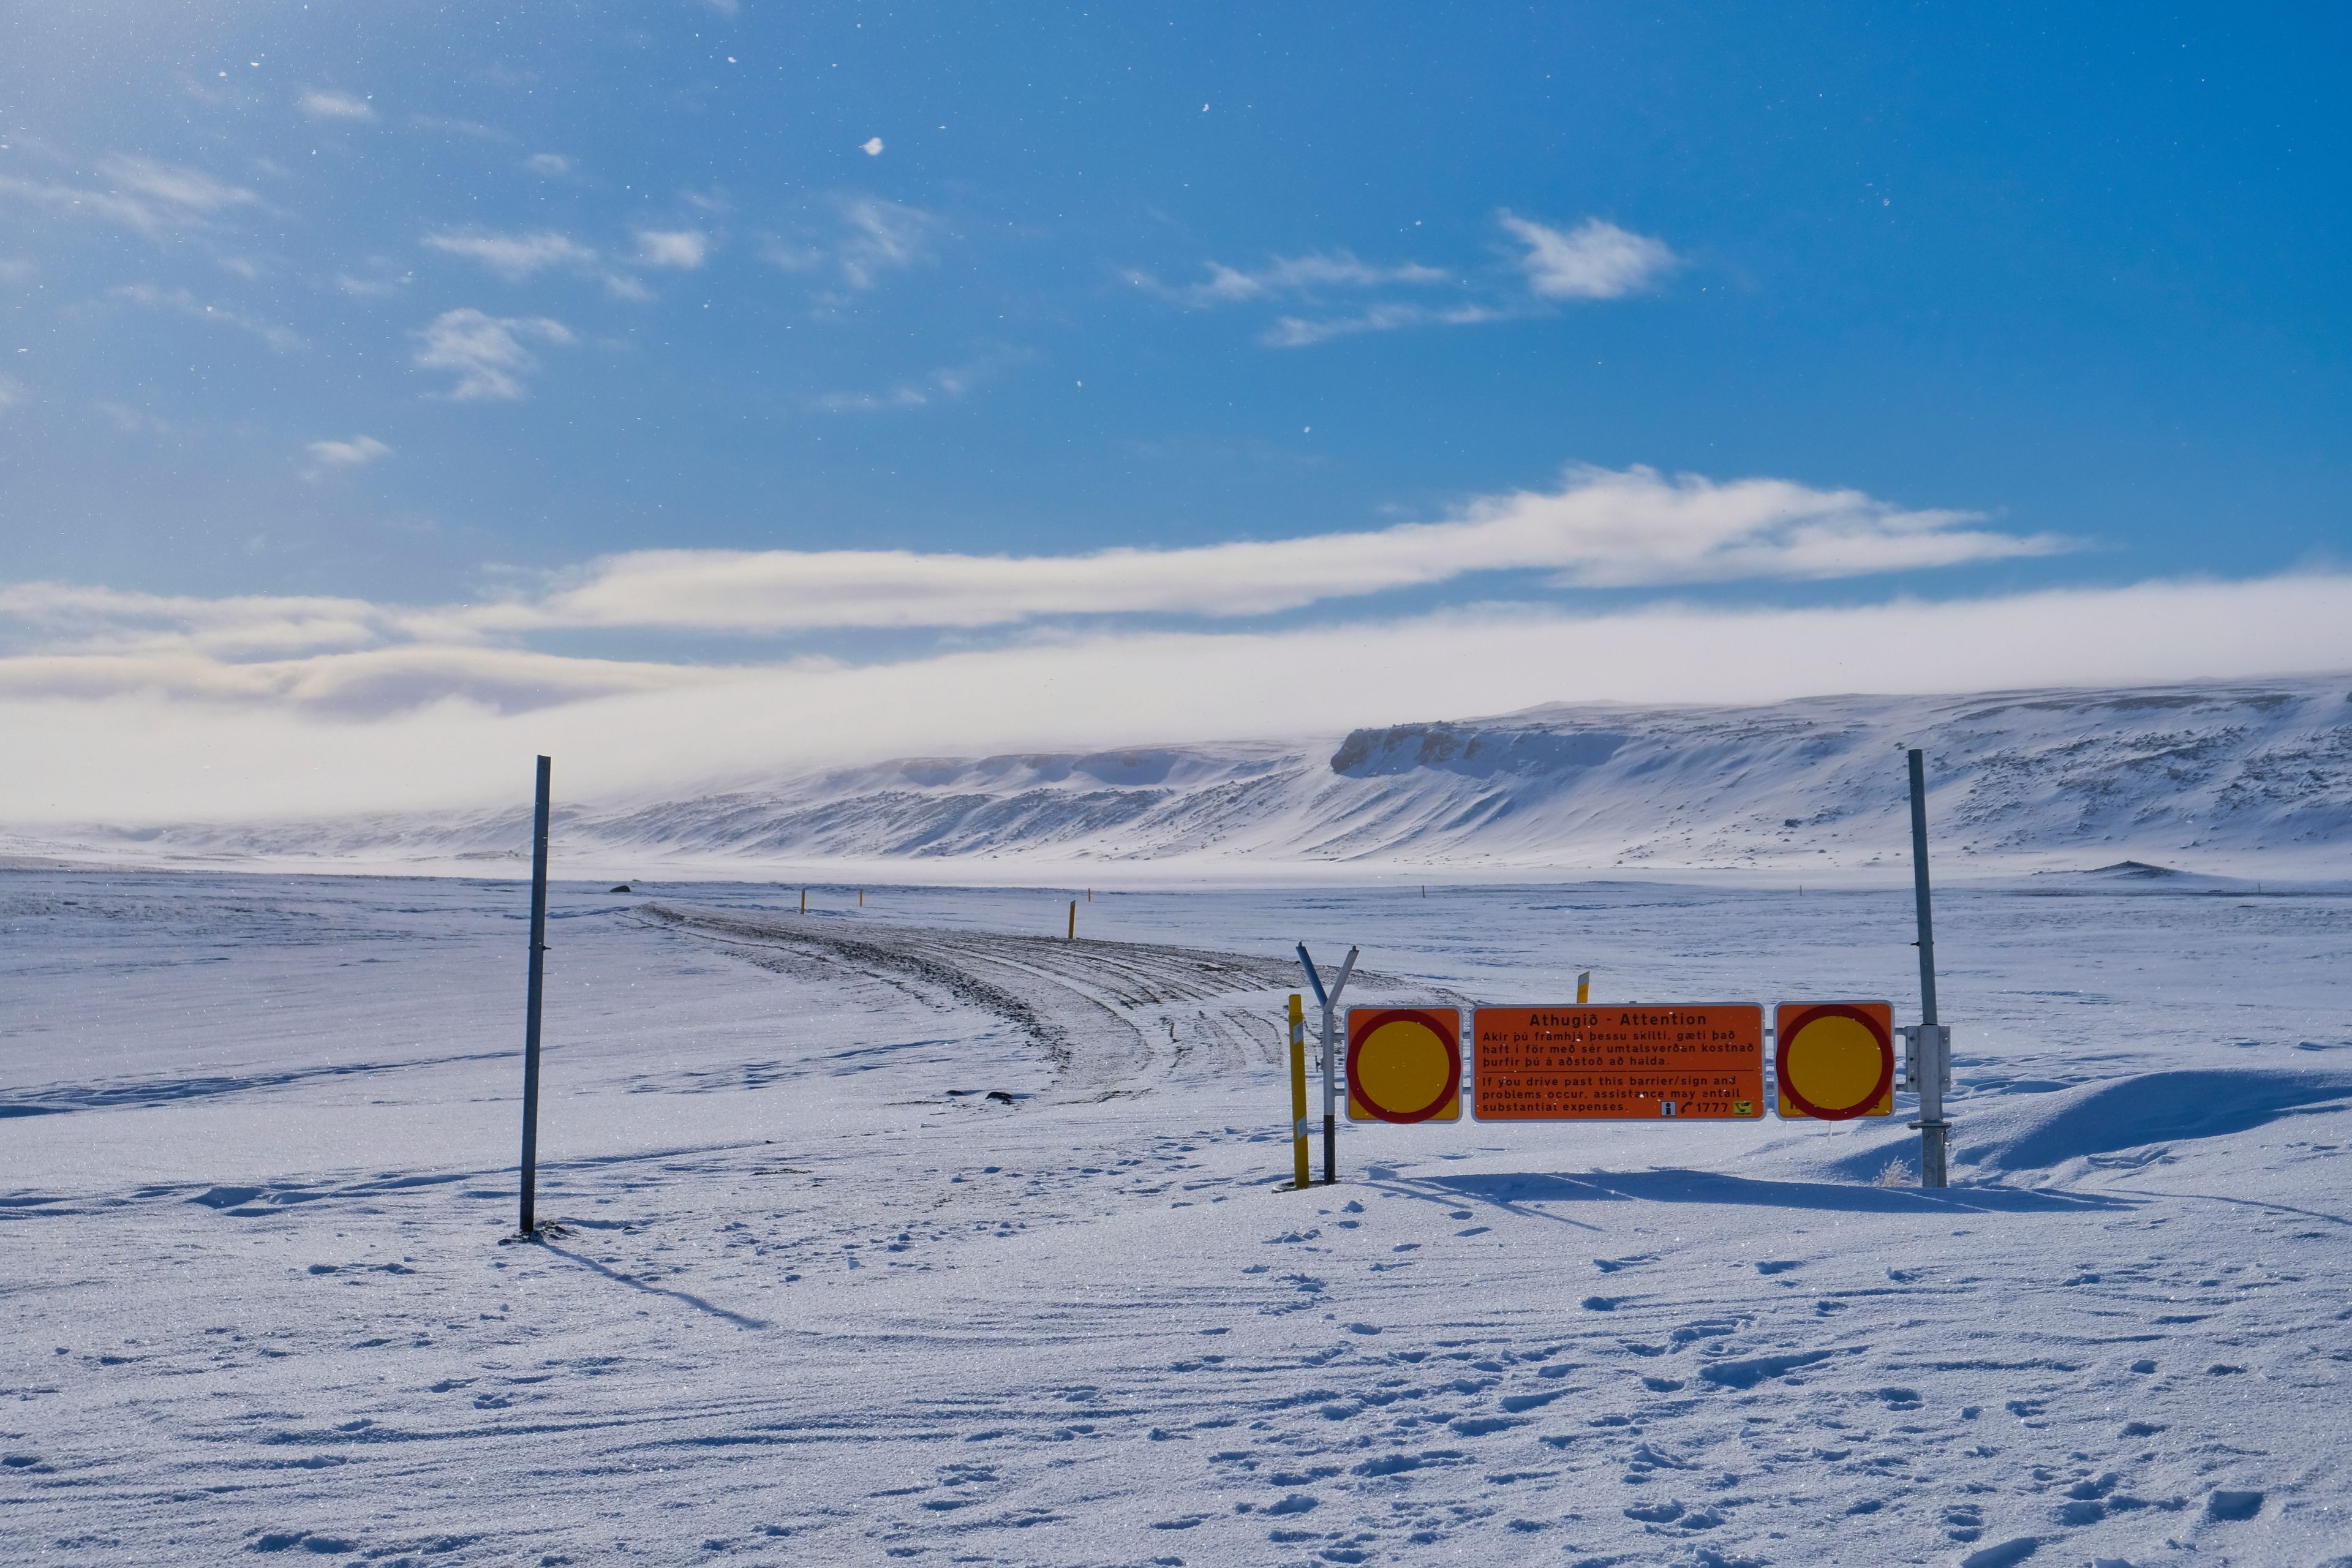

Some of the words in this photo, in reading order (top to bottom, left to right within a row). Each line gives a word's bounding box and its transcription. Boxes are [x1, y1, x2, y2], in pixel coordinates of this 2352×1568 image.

[1529, 1014, 1598, 1028] Athugið
[1619, 1012, 1707, 1026] Attention
[1482, 1032, 1509, 1041] Akir
[1513, 1032, 1528, 1043] þú
[1534, 1031, 1583, 1042] framhjá
[1589, 1031, 1627, 1042] þessu
[1676, 1030, 1707, 1042] gæti
[1712, 1030, 1736, 1042] það
[1482, 1044, 1510, 1054] haft
[1525, 1044, 1545, 1054] för
[1549, 1044, 1576, 1054] með
[1581, 1043, 1602, 1054] sér
[1607, 1042, 1696, 1054] umtalsverðan
[1701, 1042, 1754, 1053] kostnað
[1483, 1057, 1520, 1068] þurfir
[1525, 1057, 1540, 1068] þú
[1546, 1057, 1553, 1066] á
[1558, 1056, 1604, 1066] aðstoð
[1609, 1056, 1624, 1066] að
[1482, 1077, 1493, 1087] If
[1498, 1079, 1521, 1088] you
[1526, 1077, 1559, 1087] drive
[1564, 1076, 1593, 1088] past
[1599, 1076, 1624, 1087] this
[1629, 1076, 1708, 1087] barrier/sign
[1713, 1076, 1736, 1085] and
[1482, 1090, 1542, 1101] problems
[1547, 1090, 1588, 1099] occur,
[1594, 1089, 1665, 1099] assistance
[1670, 1089, 1696, 1099] may
[1702, 1088, 1741, 1098] entail
[1482, 1102, 1558, 1112] substantial
[1562, 1102, 1629, 1113] expenses.
[1696, 1101, 1729, 1114] 1777
